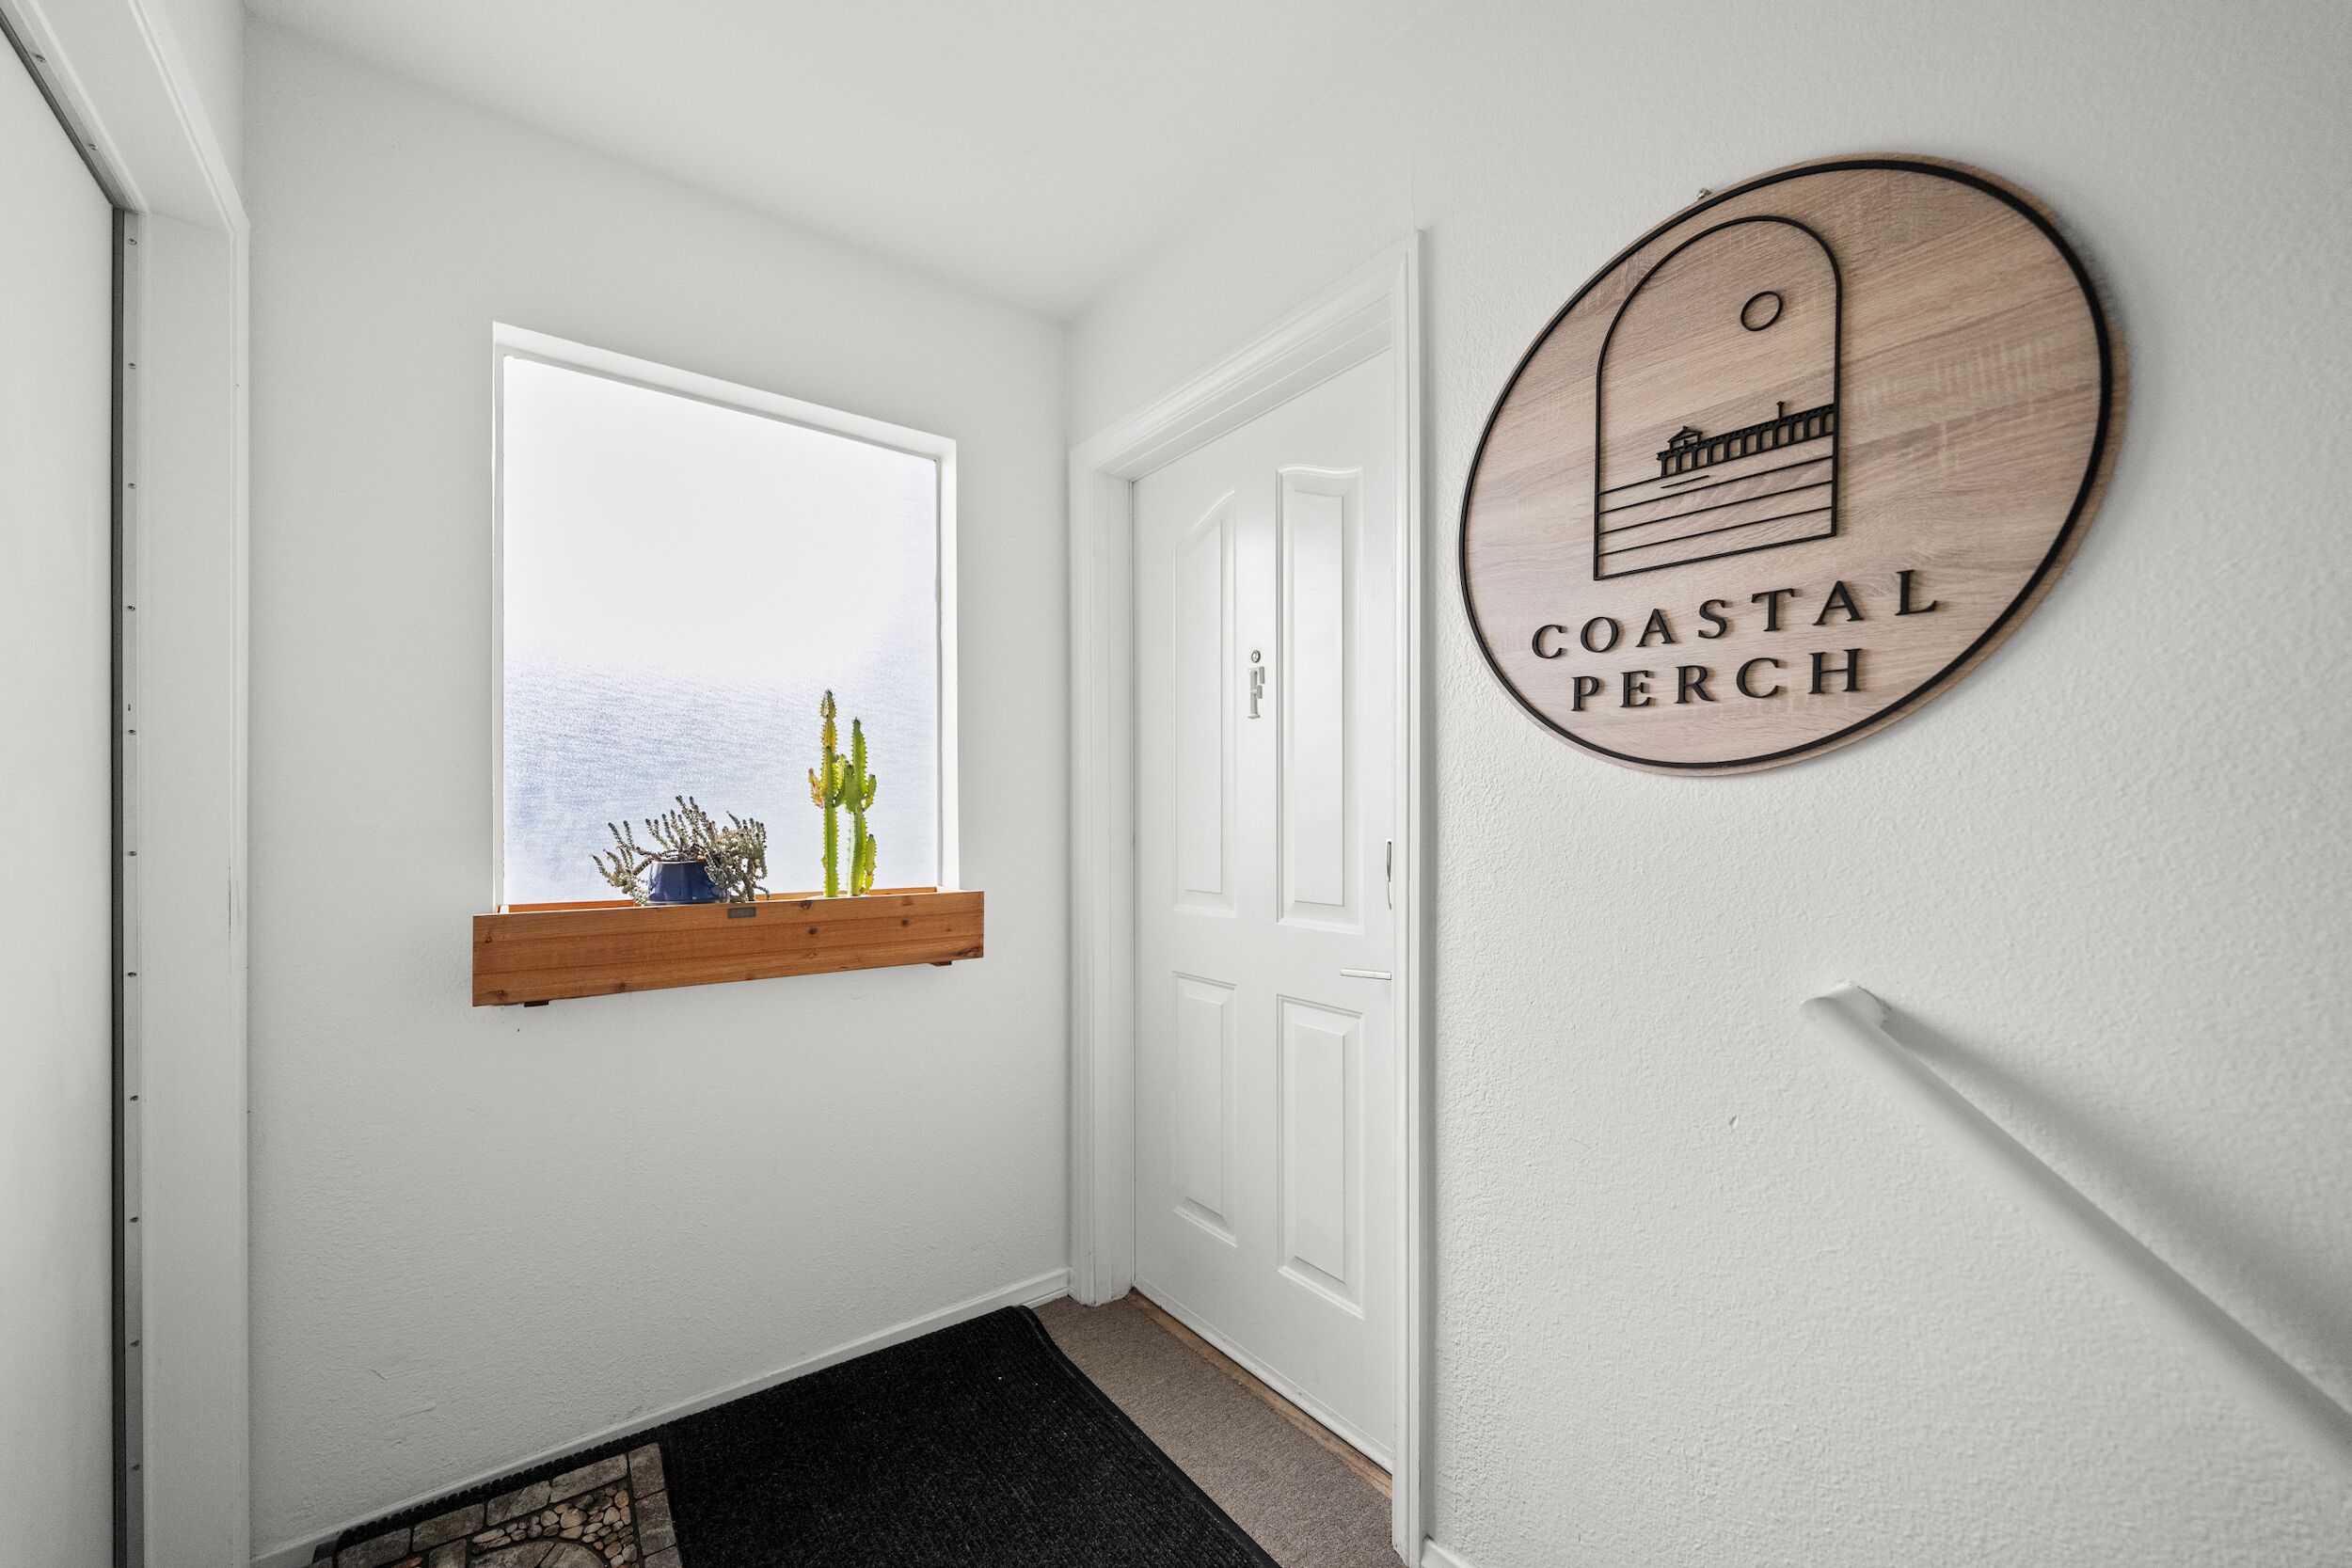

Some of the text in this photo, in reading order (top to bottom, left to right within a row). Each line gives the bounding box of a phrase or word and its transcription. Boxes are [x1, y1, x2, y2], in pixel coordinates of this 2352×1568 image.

[1533, 569, 1938, 658] COASTAL
[1248, 666, 1265, 720] F
[1571, 648, 1862, 711] PERCH
